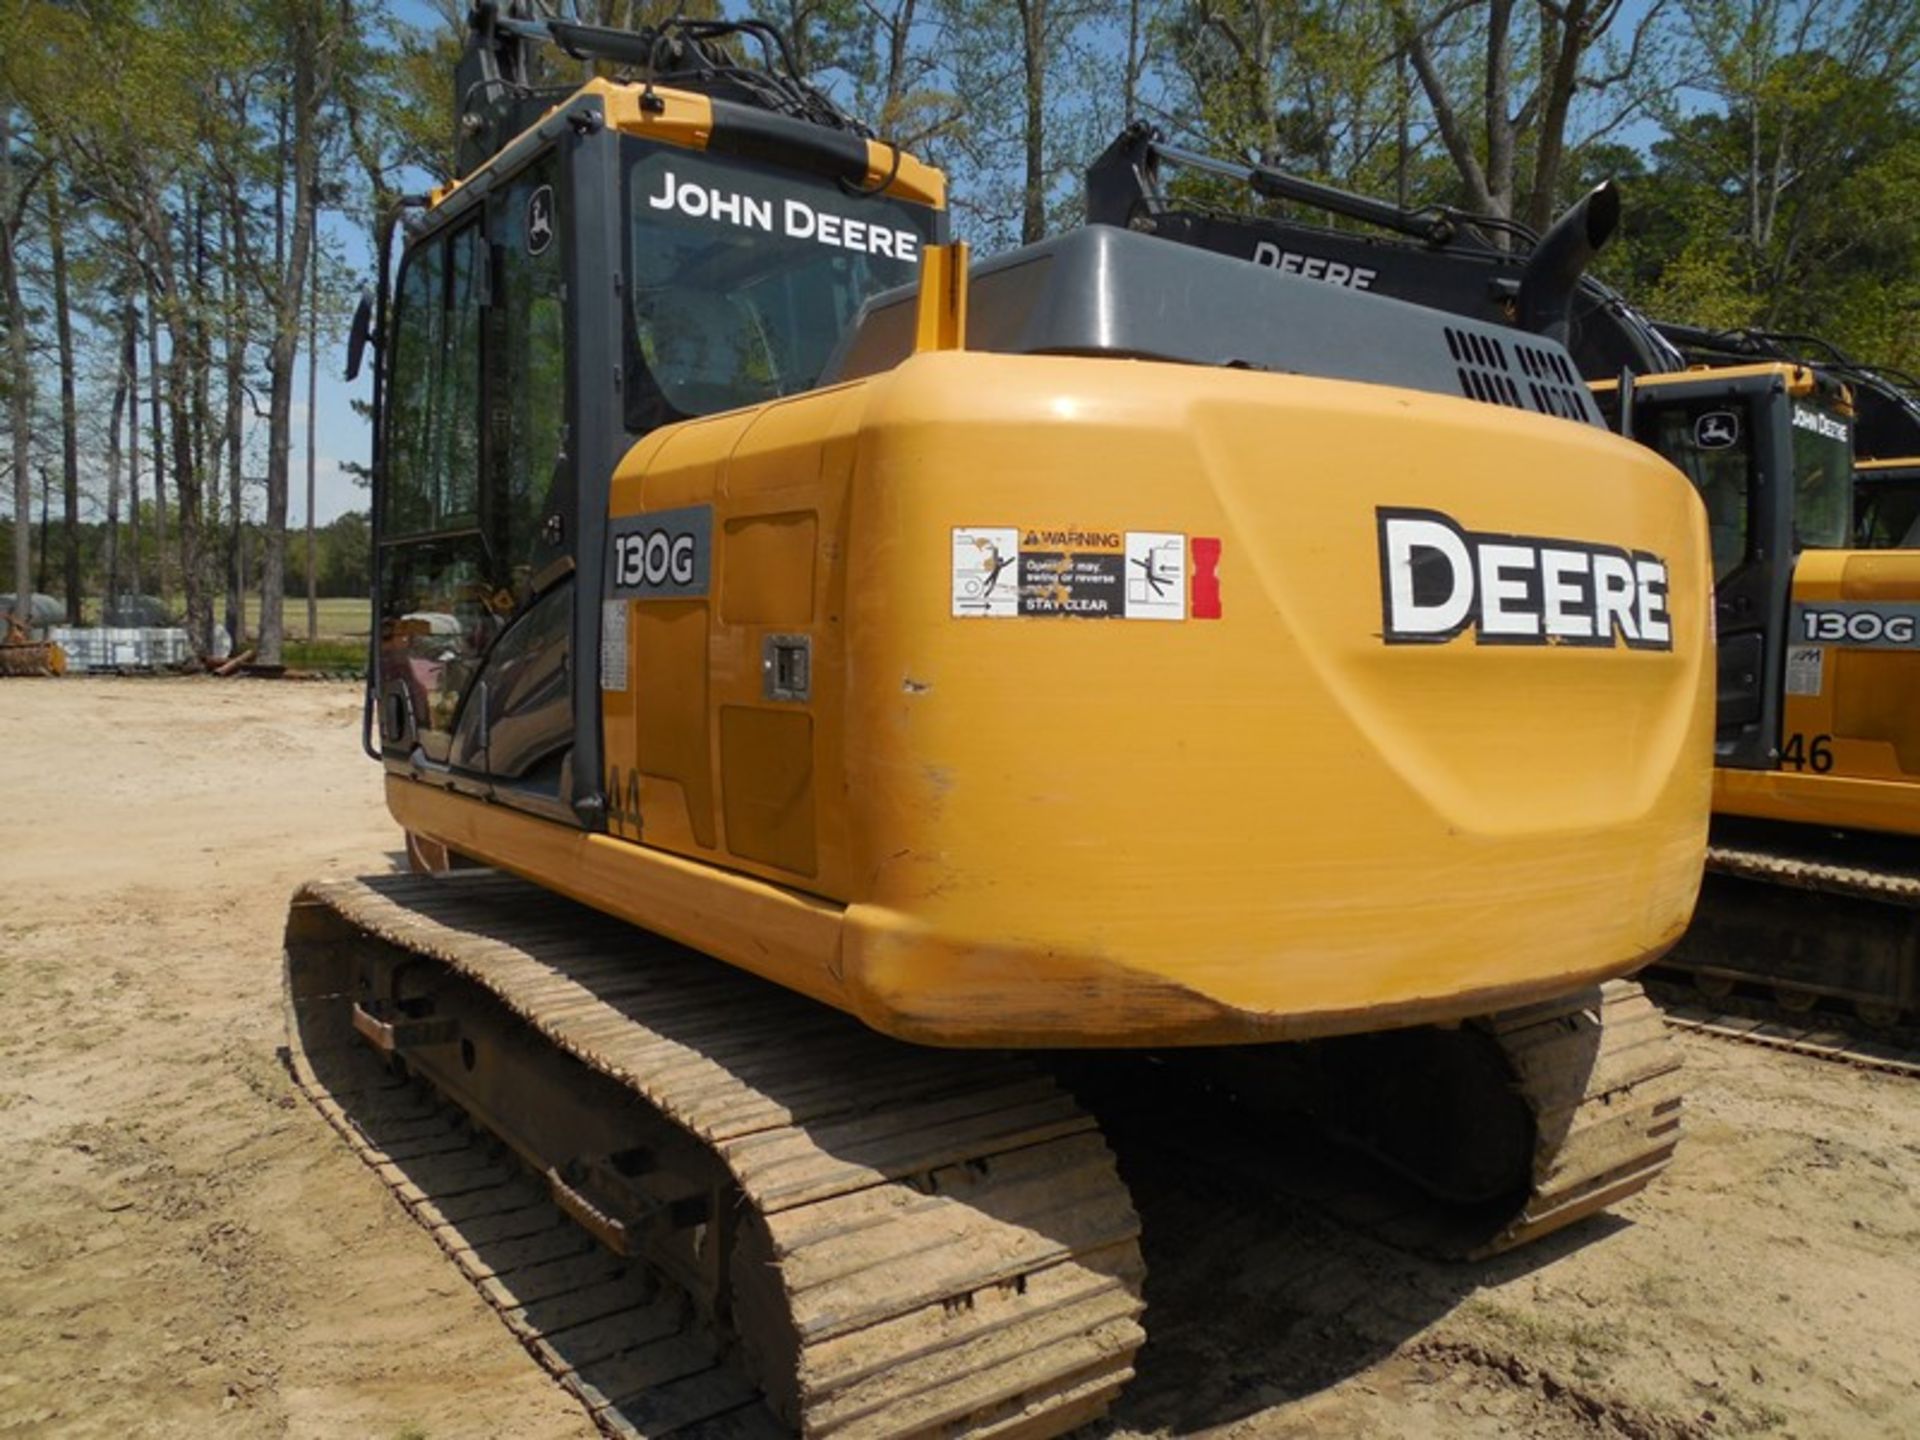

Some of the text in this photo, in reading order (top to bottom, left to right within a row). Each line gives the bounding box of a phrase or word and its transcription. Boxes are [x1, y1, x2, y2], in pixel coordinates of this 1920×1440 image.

[650, 171, 918, 262] JOHN DEERE
[1253, 241, 1377, 290] DEERE
[614, 531, 695, 587] 130G
[1041, 530, 1120, 548] WARNING
[1060, 573, 1073, 584] or
[1074, 573, 1115, 584] reverse
[1383, 515, 1671, 644] DEERE
[1064, 599, 1108, 611] CLEAR
[1803, 612, 1914, 643] 130G
[1782, 733, 1833, 774] 46
[606, 765, 645, 840] 44
